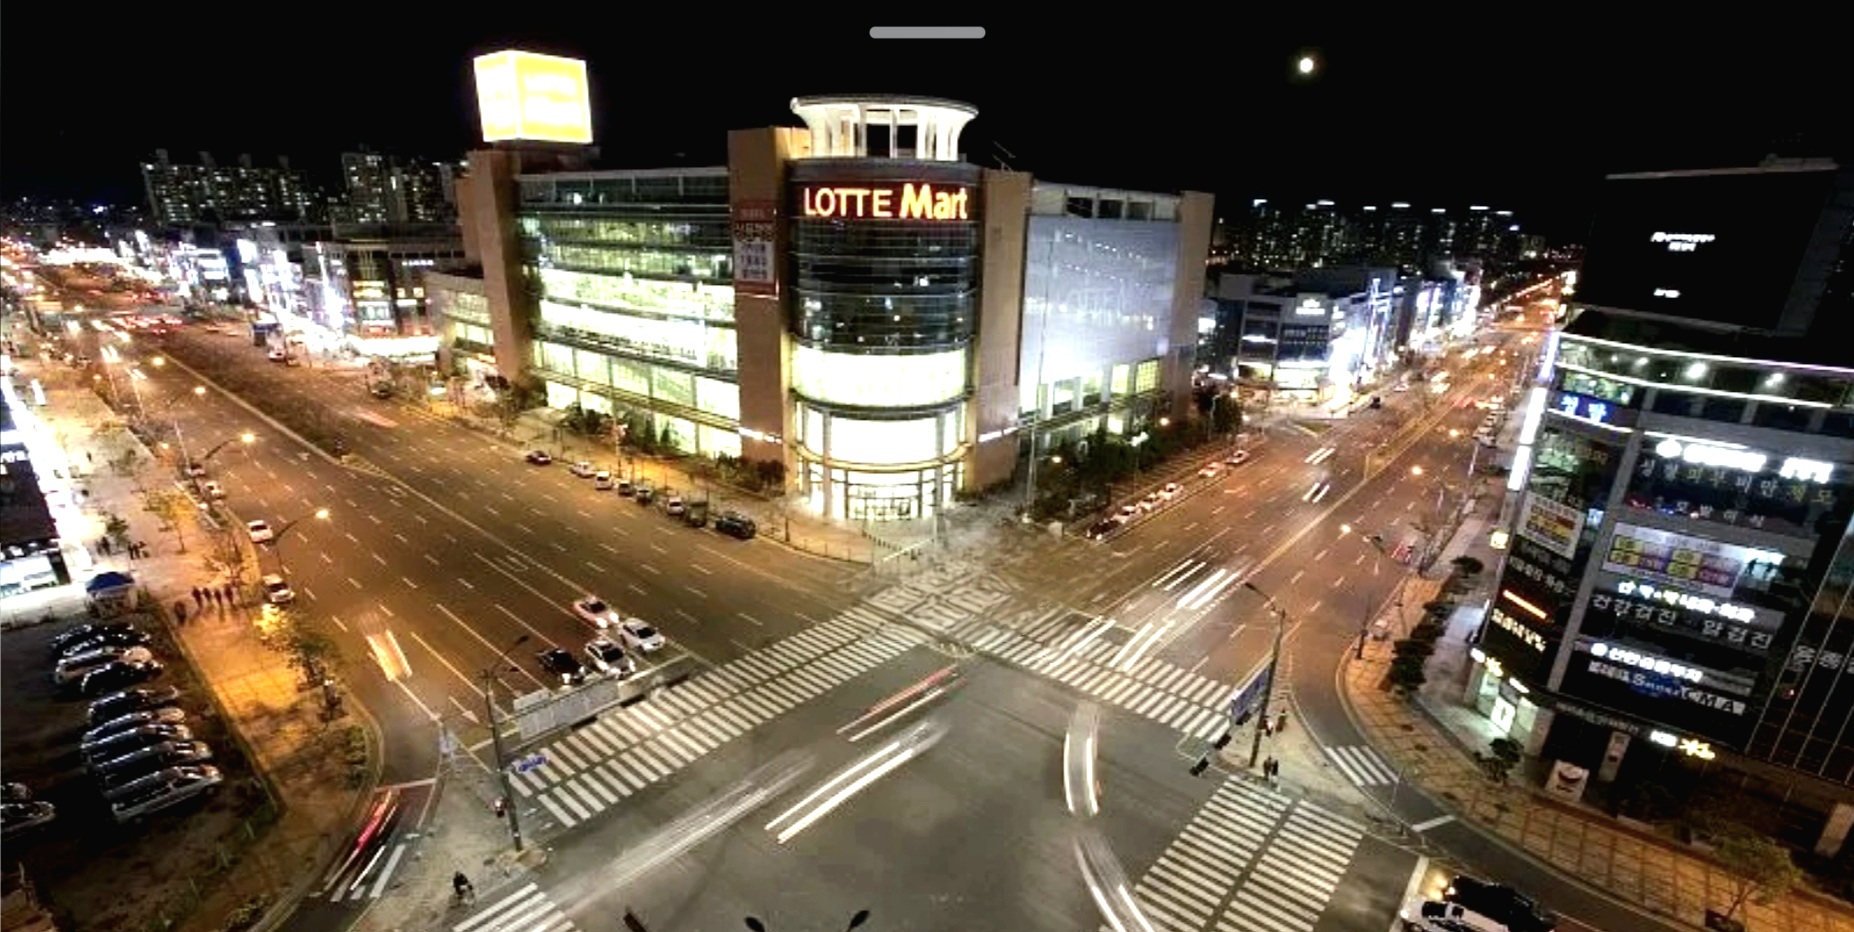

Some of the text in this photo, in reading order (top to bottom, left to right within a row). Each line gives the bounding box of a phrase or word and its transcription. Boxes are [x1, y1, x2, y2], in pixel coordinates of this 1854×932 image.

[804, 183, 968, 219] LOTTE Mart
[1735, 475, 1776, 498] 비만
[1702, 620, 1770, 650] 암검진
